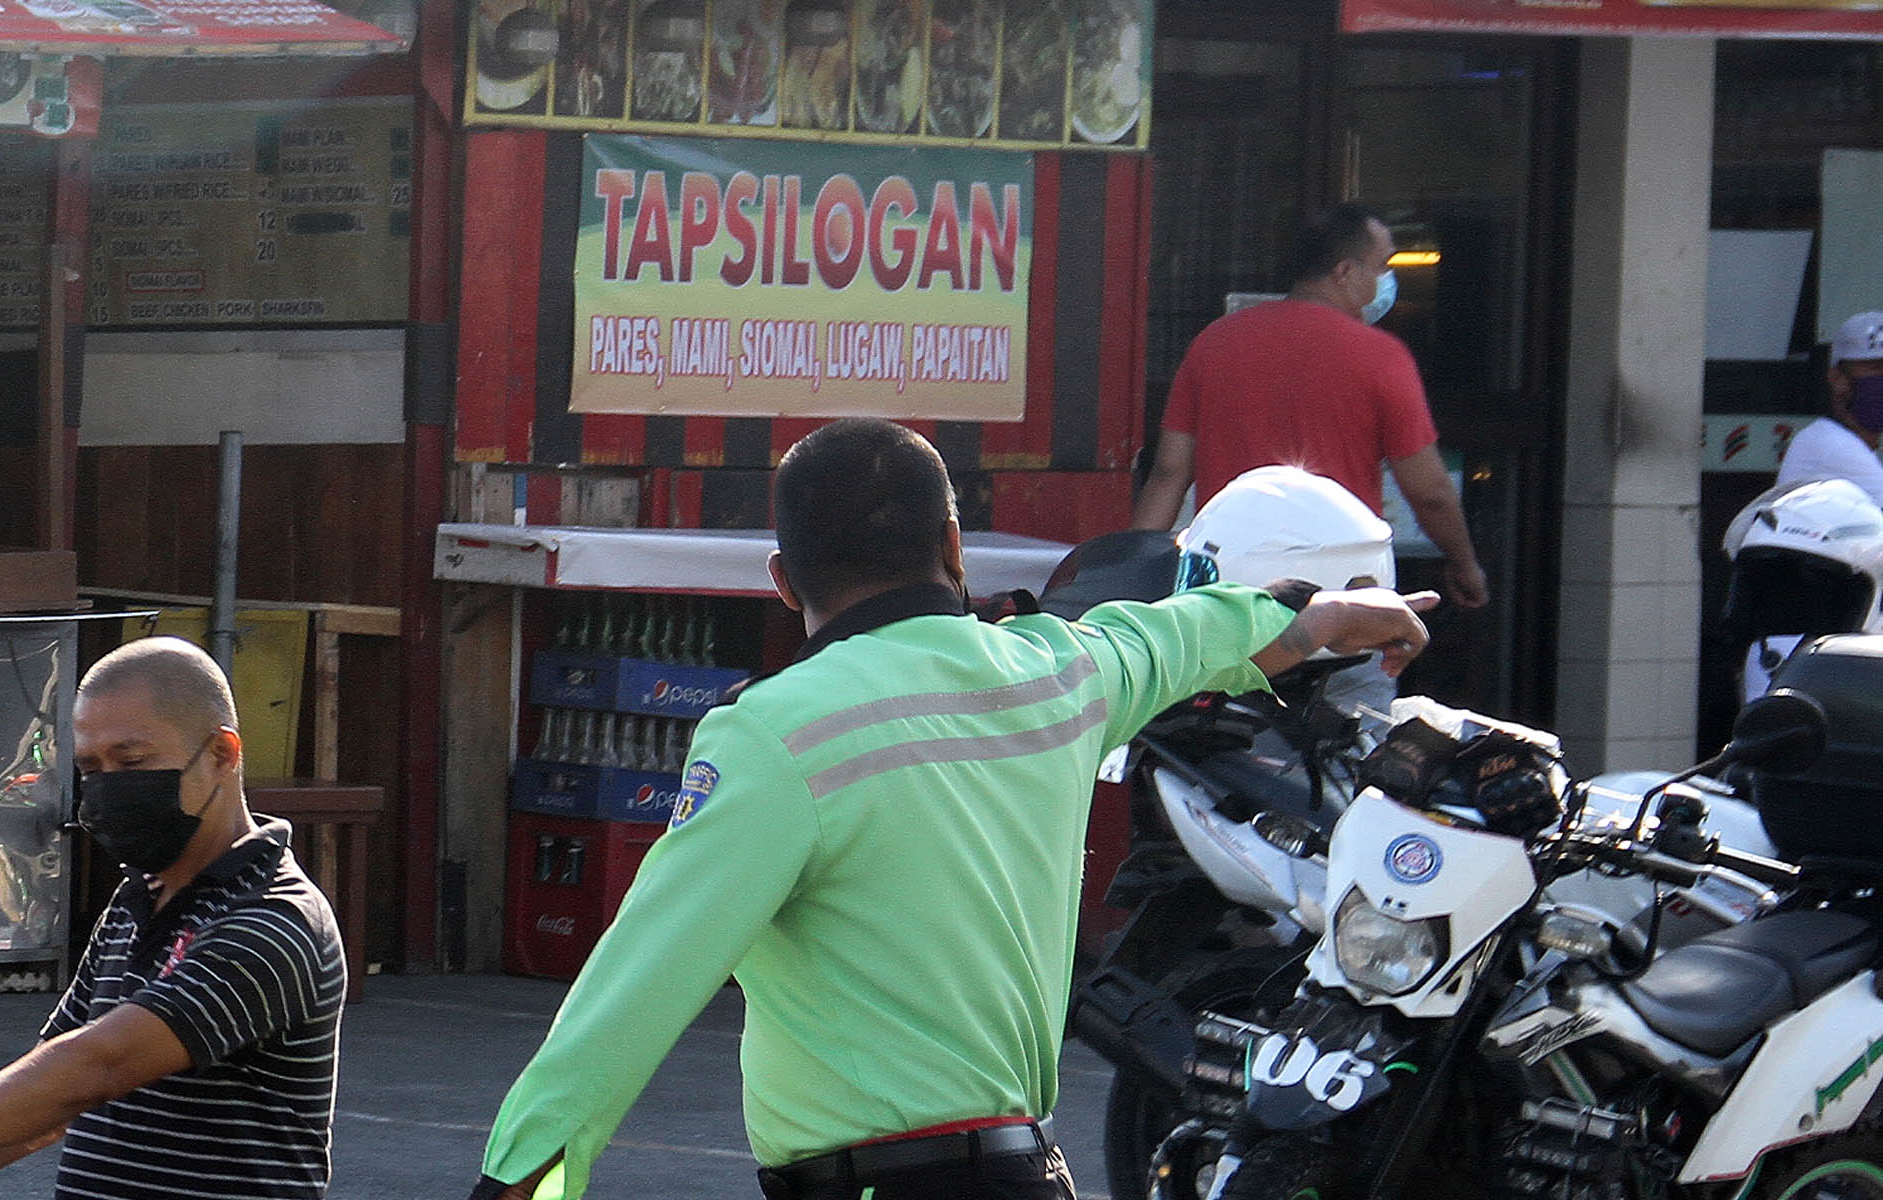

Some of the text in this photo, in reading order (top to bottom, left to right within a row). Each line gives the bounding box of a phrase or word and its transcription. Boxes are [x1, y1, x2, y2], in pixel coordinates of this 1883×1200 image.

[595, 168, 1020, 294] TAPSILOGAN
[590, 315, 1011, 394] PARES, MAMI, SIOMAI, LUGAW, PAPAITAN
